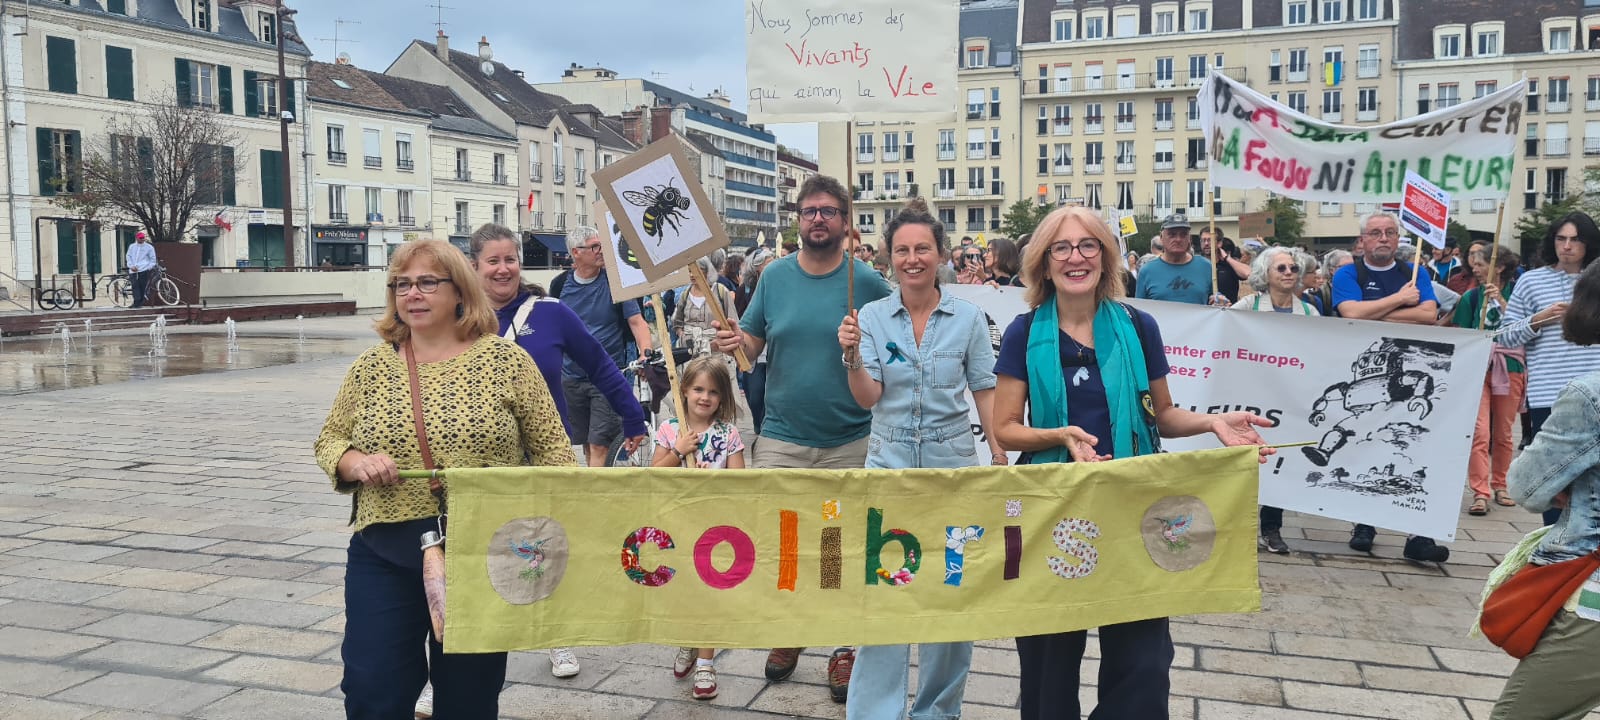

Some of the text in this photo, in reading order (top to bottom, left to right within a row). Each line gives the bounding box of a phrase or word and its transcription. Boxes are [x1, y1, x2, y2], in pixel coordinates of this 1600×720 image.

[749, 0, 791, 34] Nous
[885, 8, 905, 32] des
[785, 39, 871, 68] Vivants
[750, 85, 781, 112] qui
[794, 86, 842, 104] aimons
[882, 65, 937, 98] Vie
[1380, 101, 1522, 139] CENTER
[1164, 344, 1305, 369] enter en Europe,
[1169, 365, 1197, 378] sez
[621, 498, 1101, 592] colibris
